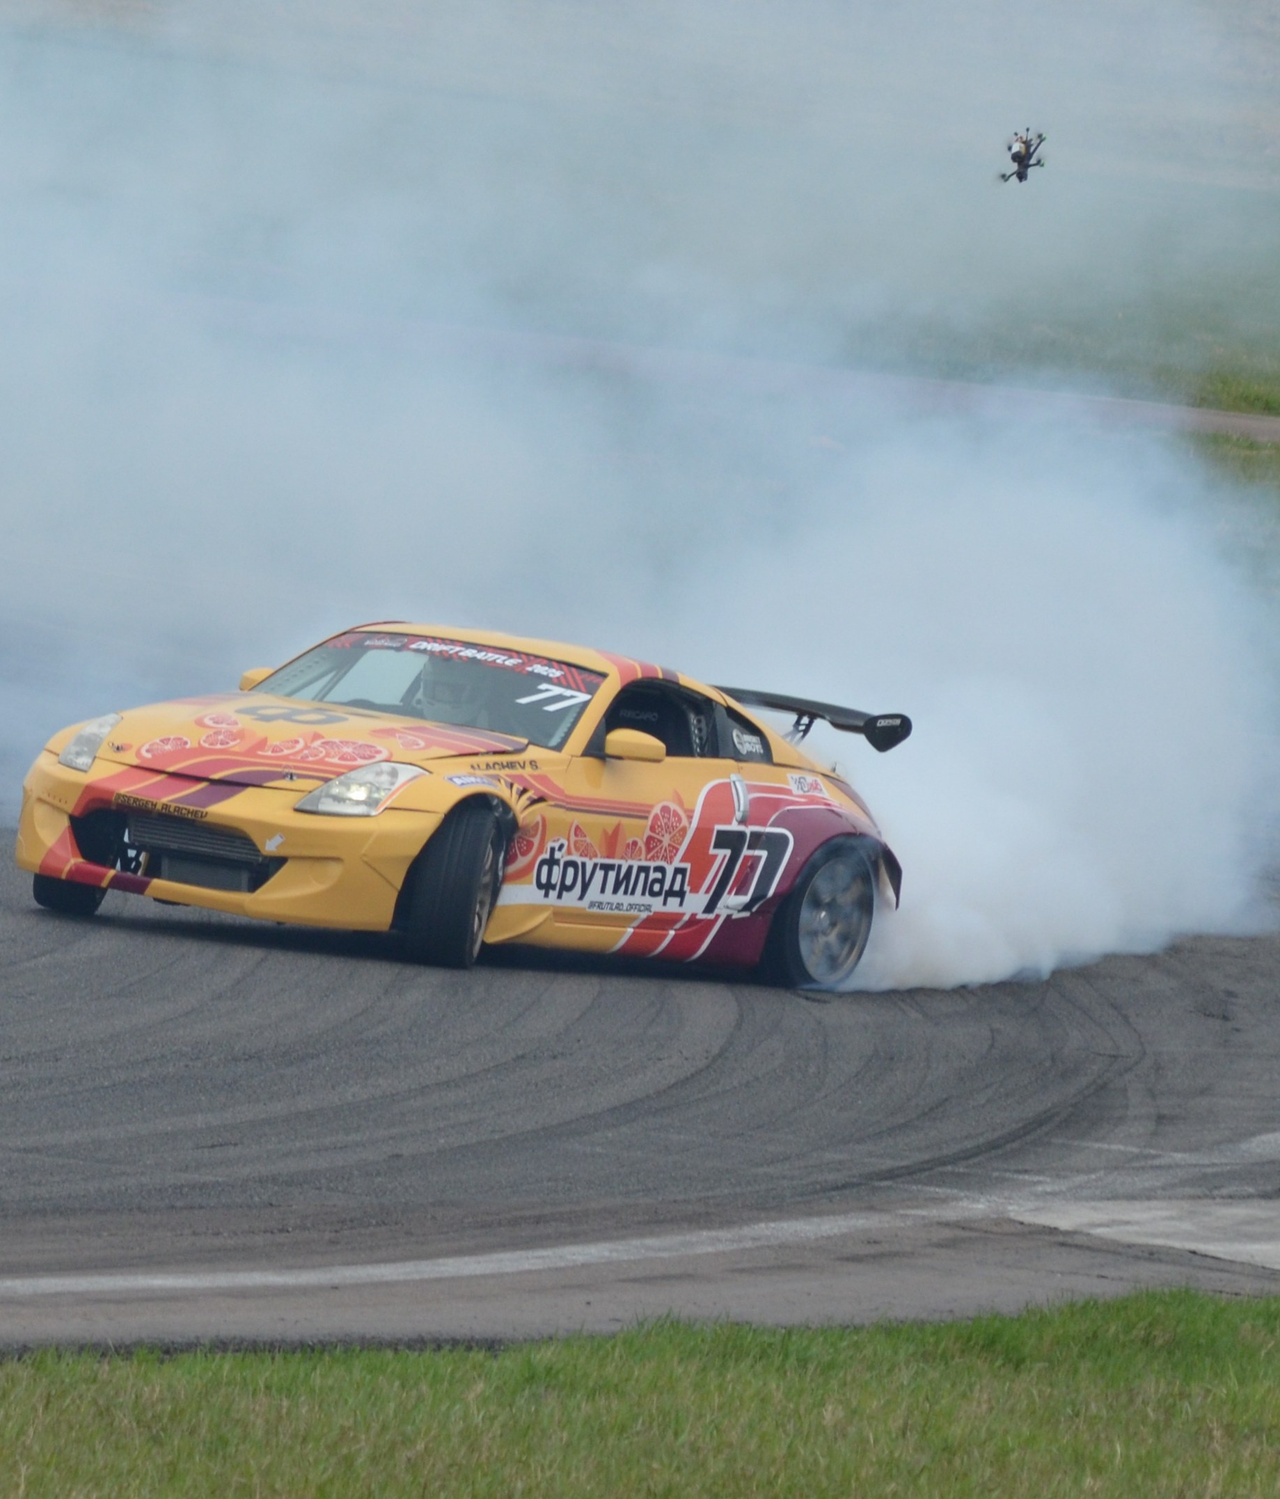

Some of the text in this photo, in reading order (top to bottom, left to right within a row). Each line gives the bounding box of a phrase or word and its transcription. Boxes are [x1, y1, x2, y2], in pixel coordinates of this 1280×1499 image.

[515, 683, 592, 712] 77
[535, 844, 689, 907] фрутилад
[702, 826, 791, 914] 77
